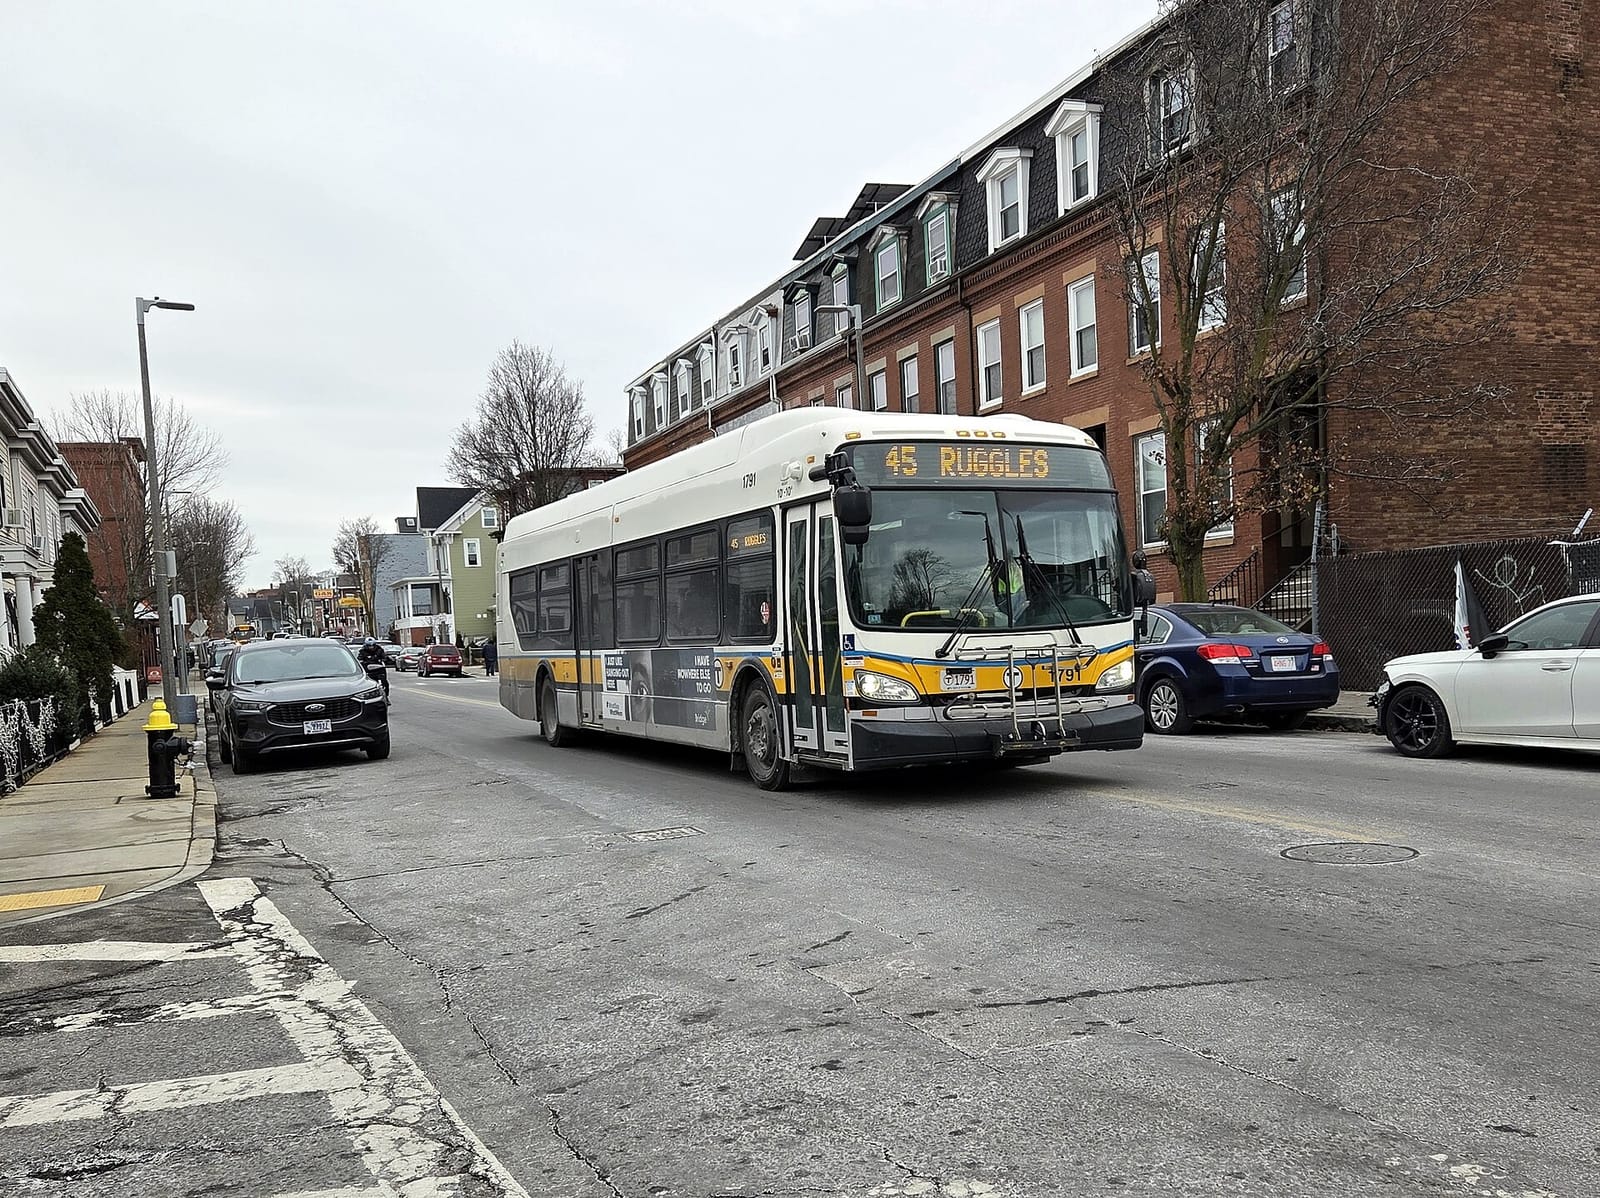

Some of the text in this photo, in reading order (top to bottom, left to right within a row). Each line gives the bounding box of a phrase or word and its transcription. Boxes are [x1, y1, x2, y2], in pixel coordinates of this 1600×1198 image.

[885, 445, 1049, 478] 45 RUGGLES
[742, 472, 757, 489] 1791
[730, 533, 767, 550] 45 RUGGLES
[697, 655, 710, 666] HAVE
[677, 668, 711, 680] NOWHERE ELSE
[955, 674, 976, 686] 1791
[696, 682, 712, 694] TO GO
